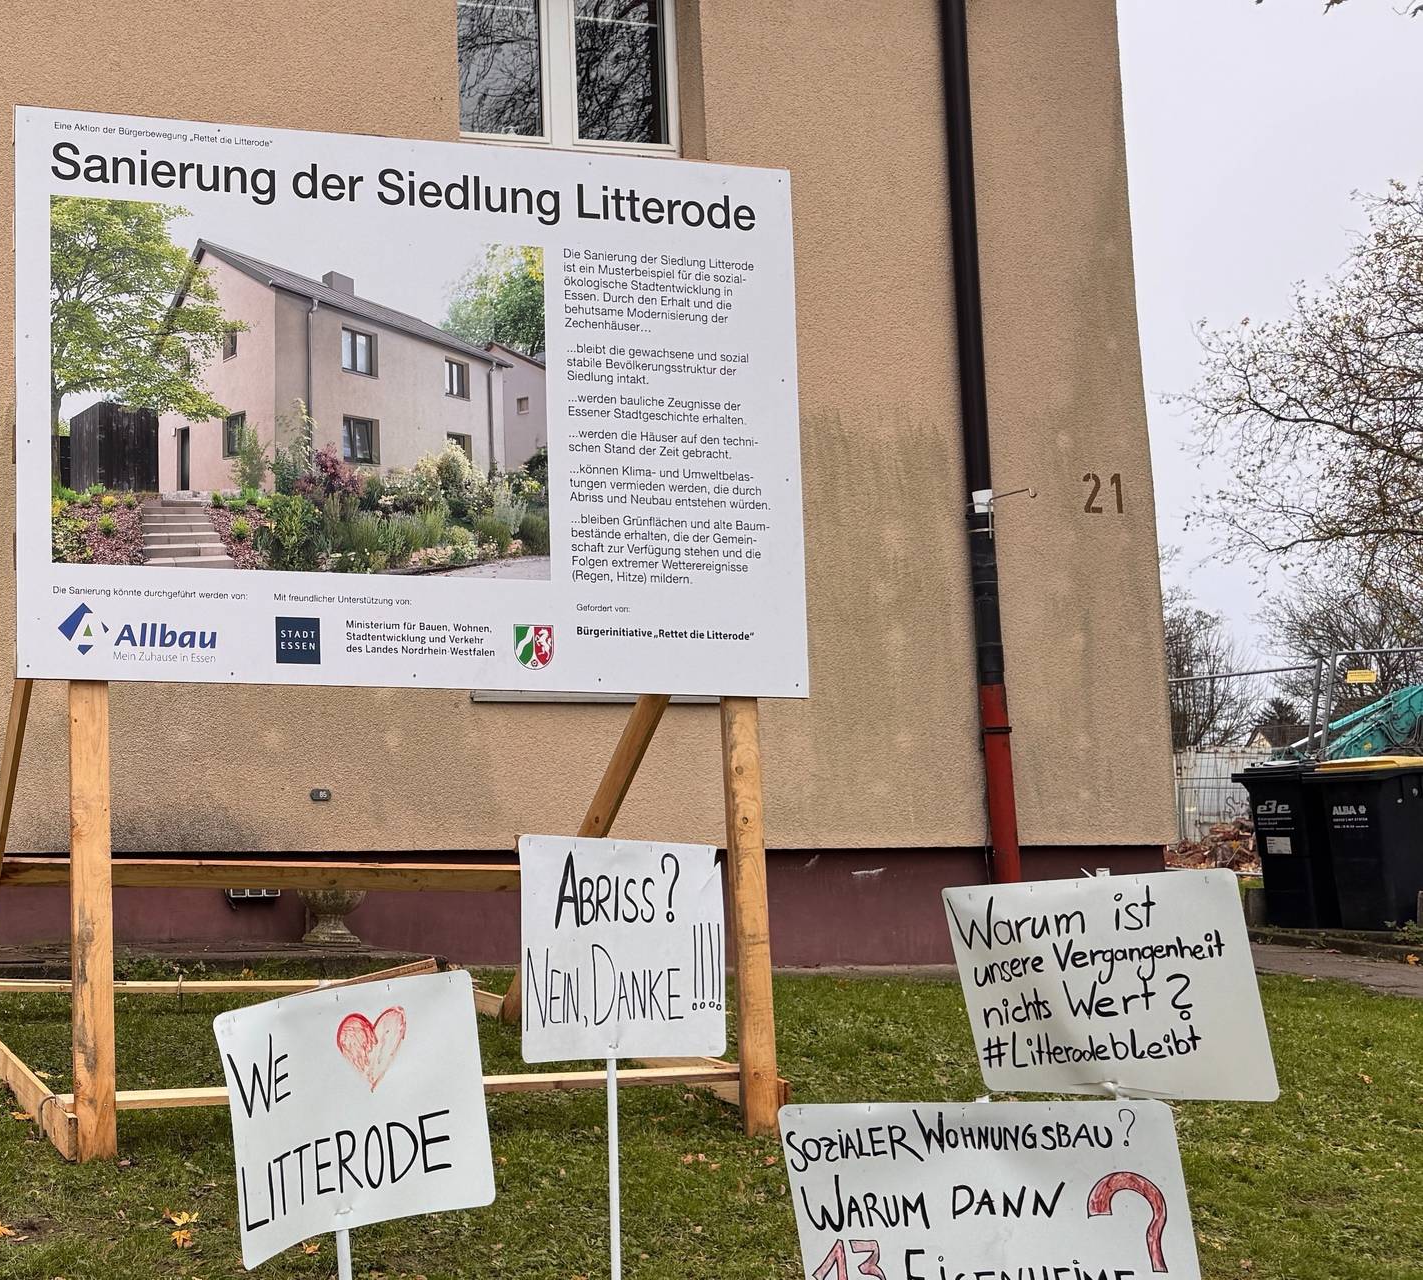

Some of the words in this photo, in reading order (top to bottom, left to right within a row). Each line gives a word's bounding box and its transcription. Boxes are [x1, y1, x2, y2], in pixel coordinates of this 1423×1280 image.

[54, 121, 72, 130] Eine
[74, 123, 100, 132] Aktion
[103, 126, 116, 134] der
[119, 127, 187, 142] Bürgerbewegung
[50, 140, 275, 208] Sanierung
[292, 163, 363, 202] der
[377, 169, 560, 225] Siedlung
[577, 184, 755, 231] Litterode
[564, 248, 580, 259] Die
[584, 250, 637, 265] Sanierung
[640, 253, 658, 264] der
[661, 255, 705, 270] Siedlung
[709, 258, 754, 271] Litterode
[564, 263, 576, 272] ist
[579, 264, 594, 274] ein
[598, 264, 674, 280] Musterbeispiel
[678, 270, 692, 280] für
[695, 272, 710, 281] die
[713, 274, 746, 284] sozial-
[564, 276, 628, 290] ökologische
[631, 280, 720, 298] Stadtentwicklung
[724, 287, 732, 296] in
[564, 290, 599, 301] Essen.
[603, 292, 634, 303] Durch
[638, 295, 657, 305] den
[661, 296, 690, 307] Erhalt
[694, 299, 713, 309] und
[716, 300, 732, 310] die
[565, 304, 624, 317] behutsame
[627, 307, 708, 325] Modernisierung
[711, 313, 728, 323] der
[609, 345, 625, 356] die
[629, 348, 694, 360] gewachsene
[698, 352, 717, 361] und
[720, 353, 749, 363] sozial
[567, 357, 602, 368] stabile
[606, 359, 717, 375] Bevölkerungsstruktur
[720, 366, 737, 376] der
[567, 370, 613, 385] Siedlung
[617, 374, 649, 384] intakt.
[620, 395, 664, 407] bauliche
[668, 397, 721, 411] Zeugnisse
[724, 401, 741, 411] der
[568, 406, 611, 418] Essener
[614, 408, 699, 423] Stadtgeschichte
[702, 415, 747, 426] erhalten.
[621, 430, 637, 441] die
[641, 431, 678, 443] Häuser
[681, 434, 697, 444] auf
[700, 435, 720, 444] den
[723, 436, 758, 446] techni-
[569, 442, 600, 453] schen
[604, 443, 635, 454] Stand
[639, 445, 656, 455] der
[659, 446, 679, 456] Zeit
[682, 448, 731, 459] gebracht.
[622, 466, 656, 477] Klima-
[660, 468, 679, 478] und
[683, 469, 753, 481] Umweltbelas-
[570, 478, 606, 491] tungen
[610, 480, 665, 491] vermieden
[669, 483, 710, 495] werden,
[713, 484, 729, 494] die
[732, 485, 761, 496] durch
[1082, 472, 1124, 514] 21
[570, 491, 603, 503] Abriss
[607, 494, 627, 504] und
[631, 494, 672, 505] Neubau
[675, 497, 726, 508] entstehen
[729, 500, 771, 510] würden.
[623, 515, 687, 528] Grünflächen
[691, 519, 710, 529] und
[714, 520, 732, 530] alte
[736, 520, 770, 531] Baum-
[571, 527, 621, 539] bestände
[624, 530, 670, 543] erhalten,
[673, 532, 689, 542] die
[692, 533, 710, 543] der
[713, 533, 757, 544] Gemein-
[571, 542, 604, 552] schaft
[608, 545, 624, 553] zur
[627, 544, 681, 558] Verfügung
[684, 546, 719, 557] stehen
[723, 548, 742, 558] und
[745, 549, 761, 559] die
[572, 556, 608, 569] Folgen
[612, 558, 659, 569] extremer
[662, 559, 748, 574] Wetterereignisse
[572, 570, 613, 583] (Regen,
[617, 571, 647, 584] Hitze)
[650, 573, 692, 584] mildern.
[53, 586, 66, 594] Die
[69, 586, 111, 597] Sanierung
[113, 588, 142, 596] könnte
[144, 590, 196, 599] durchgeführt
[274, 593, 286, 601] Mit
[289, 594, 335, 603] freundlicher
[338, 596, 393, 606] Unterstützung
[281, 630, 315, 638] STADT
[346, 620, 400, 629] Ministerium
[403, 622, 416, 630] für
[419, 622, 450, 632] Bauen,
[453, 623, 492, 633] Wohnen,
[577, 626, 652, 638] Bürgerinitiative
[690, 630, 704, 639] die
[114, 623, 217, 649] Allbau
[346, 632, 426, 644] Stadtentwicklung
[429, 635, 446, 643] und
[449, 635, 484, 644] Verkehr
[281, 642, 315, 650] ESSEN
[346, 644, 362, 653] des
[366, 645, 398, 654] Landes
[113, 651, 136, 661] Mein
[139, 651, 177, 662] Zuhause
[180, 653, 188, 662] in
[191, 653, 216, 663] Essen
[1332, 805, 1357, 815] ALBA
[946, 895, 1086, 950] Warum
[1113, 885, 1157, 931] ist
[973, 954, 1044, 987] unsere
[1052, 929, 1225, 985] Vergangenheit
[983, 987, 1053, 1029] nichts
[227, 1033, 291, 1119] WE
[241, 1109, 452, 1232] LITTERODE
[801, 1174, 930, 1233] WARUM
[952, 1181, 1065, 1220] DANN
